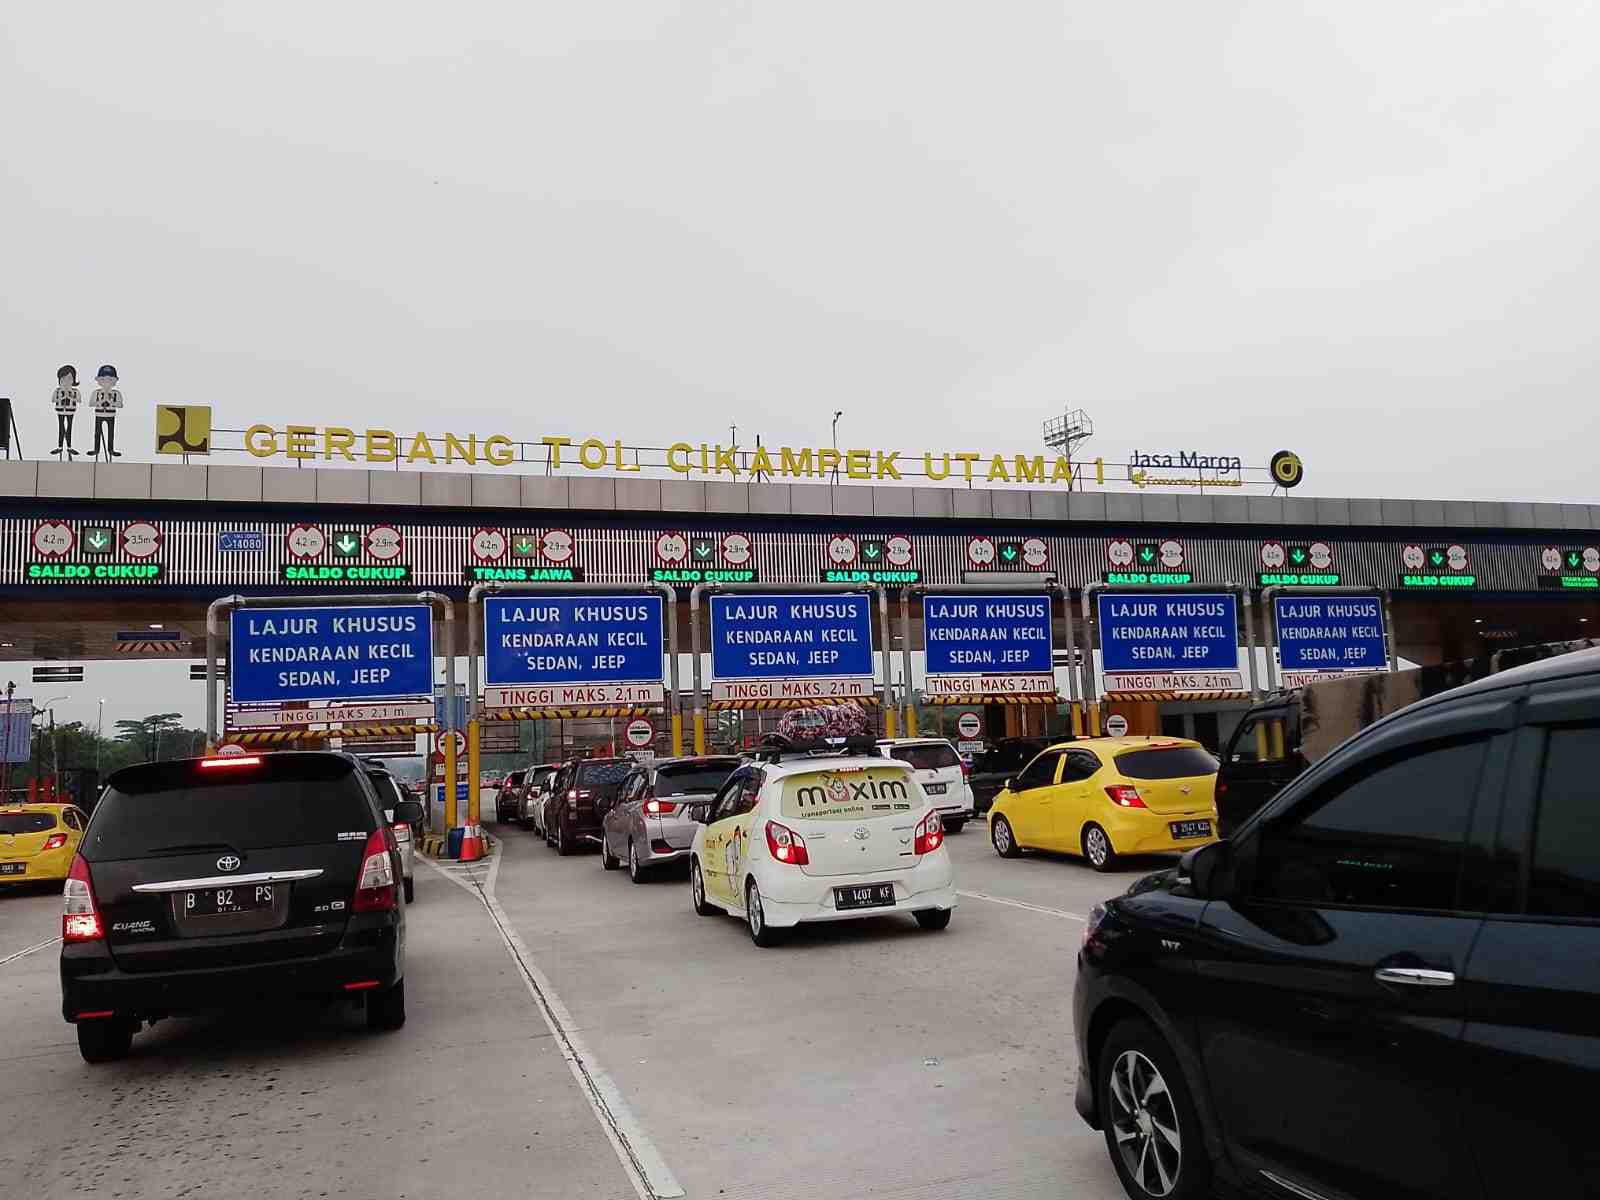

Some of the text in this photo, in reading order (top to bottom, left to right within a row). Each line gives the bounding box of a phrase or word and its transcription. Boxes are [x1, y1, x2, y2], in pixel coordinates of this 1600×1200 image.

[244, 423, 514, 466] GERBANG
[542, 436, 641, 472] TOL
[666, 442, 902, 480] CIKAMPEK
[924, 452, 1073, 484] UTAMA
[1133, 450, 1241, 475] Jasa Marga
[232, 539, 262, 549] 14080
[29, 565, 160, 578] SALDO CUKUP
[286, 567, 406, 579] SALDO CUKUP
[474, 568, 574, 581] TRANS JAWA
[654, 570, 753, 582] SALDO CUKUP
[826, 571, 919, 583] SALDO CUKUP
[1108, 573, 1191, 584] SALDO CUKUP
[1261, 574, 1339, 585] SALDO CUKUP
[501, 606, 648, 622] LAJUR KHUSUS
[725, 604, 857, 620] LAJUR KHUSUS
[930, 604, 1045, 618] LAJUR KHUSUS
[1111, 603, 1225, 617] LAJUR KHUSUS
[1280, 604, 1377, 619] LAJUR KHUSUS
[249, 616, 416, 636] LAJUR KHUSUS
[1112, 625, 1226, 640] KENDARAAN KECIL
[1281, 625, 1380, 640] KENDARAAN KECIL
[502, 632, 648, 648] KENDARAAN KECIL
[726, 629, 858, 644] KENDARAAN KECIL
[930, 627, 1046, 641] KENDARAAN KECIL
[249, 644, 415, 663] KENDARAAN KECIL
[807, 650, 839, 664] JEEP
[1000, 649, 1030, 662] JEEP
[1181, 645, 1209, 659] JEEP
[1343, 647, 1367, 660] JEEP
[591, 655, 626, 669] JEEP
[350, 669, 391, 685] JEEP
[1115, 676, 1156, 689] TINGGI
[1220, 677, 1232, 687] m
[725, 684, 773, 698] TINGGI
[782, 682, 824, 696] MAKS.
[850, 683, 861, 695] m
[931, 679, 975, 692] TINGGI
[1038, 680, 1049, 690] m
[500, 689, 554, 705] TINGGI
[562, 688, 610, 702] MAKS.
[638, 689, 650, 700] m
[272, 711, 319, 722] TINGGI
[394, 708, 404, 718] m
[187, 885, 272, 909] B 82 PS
